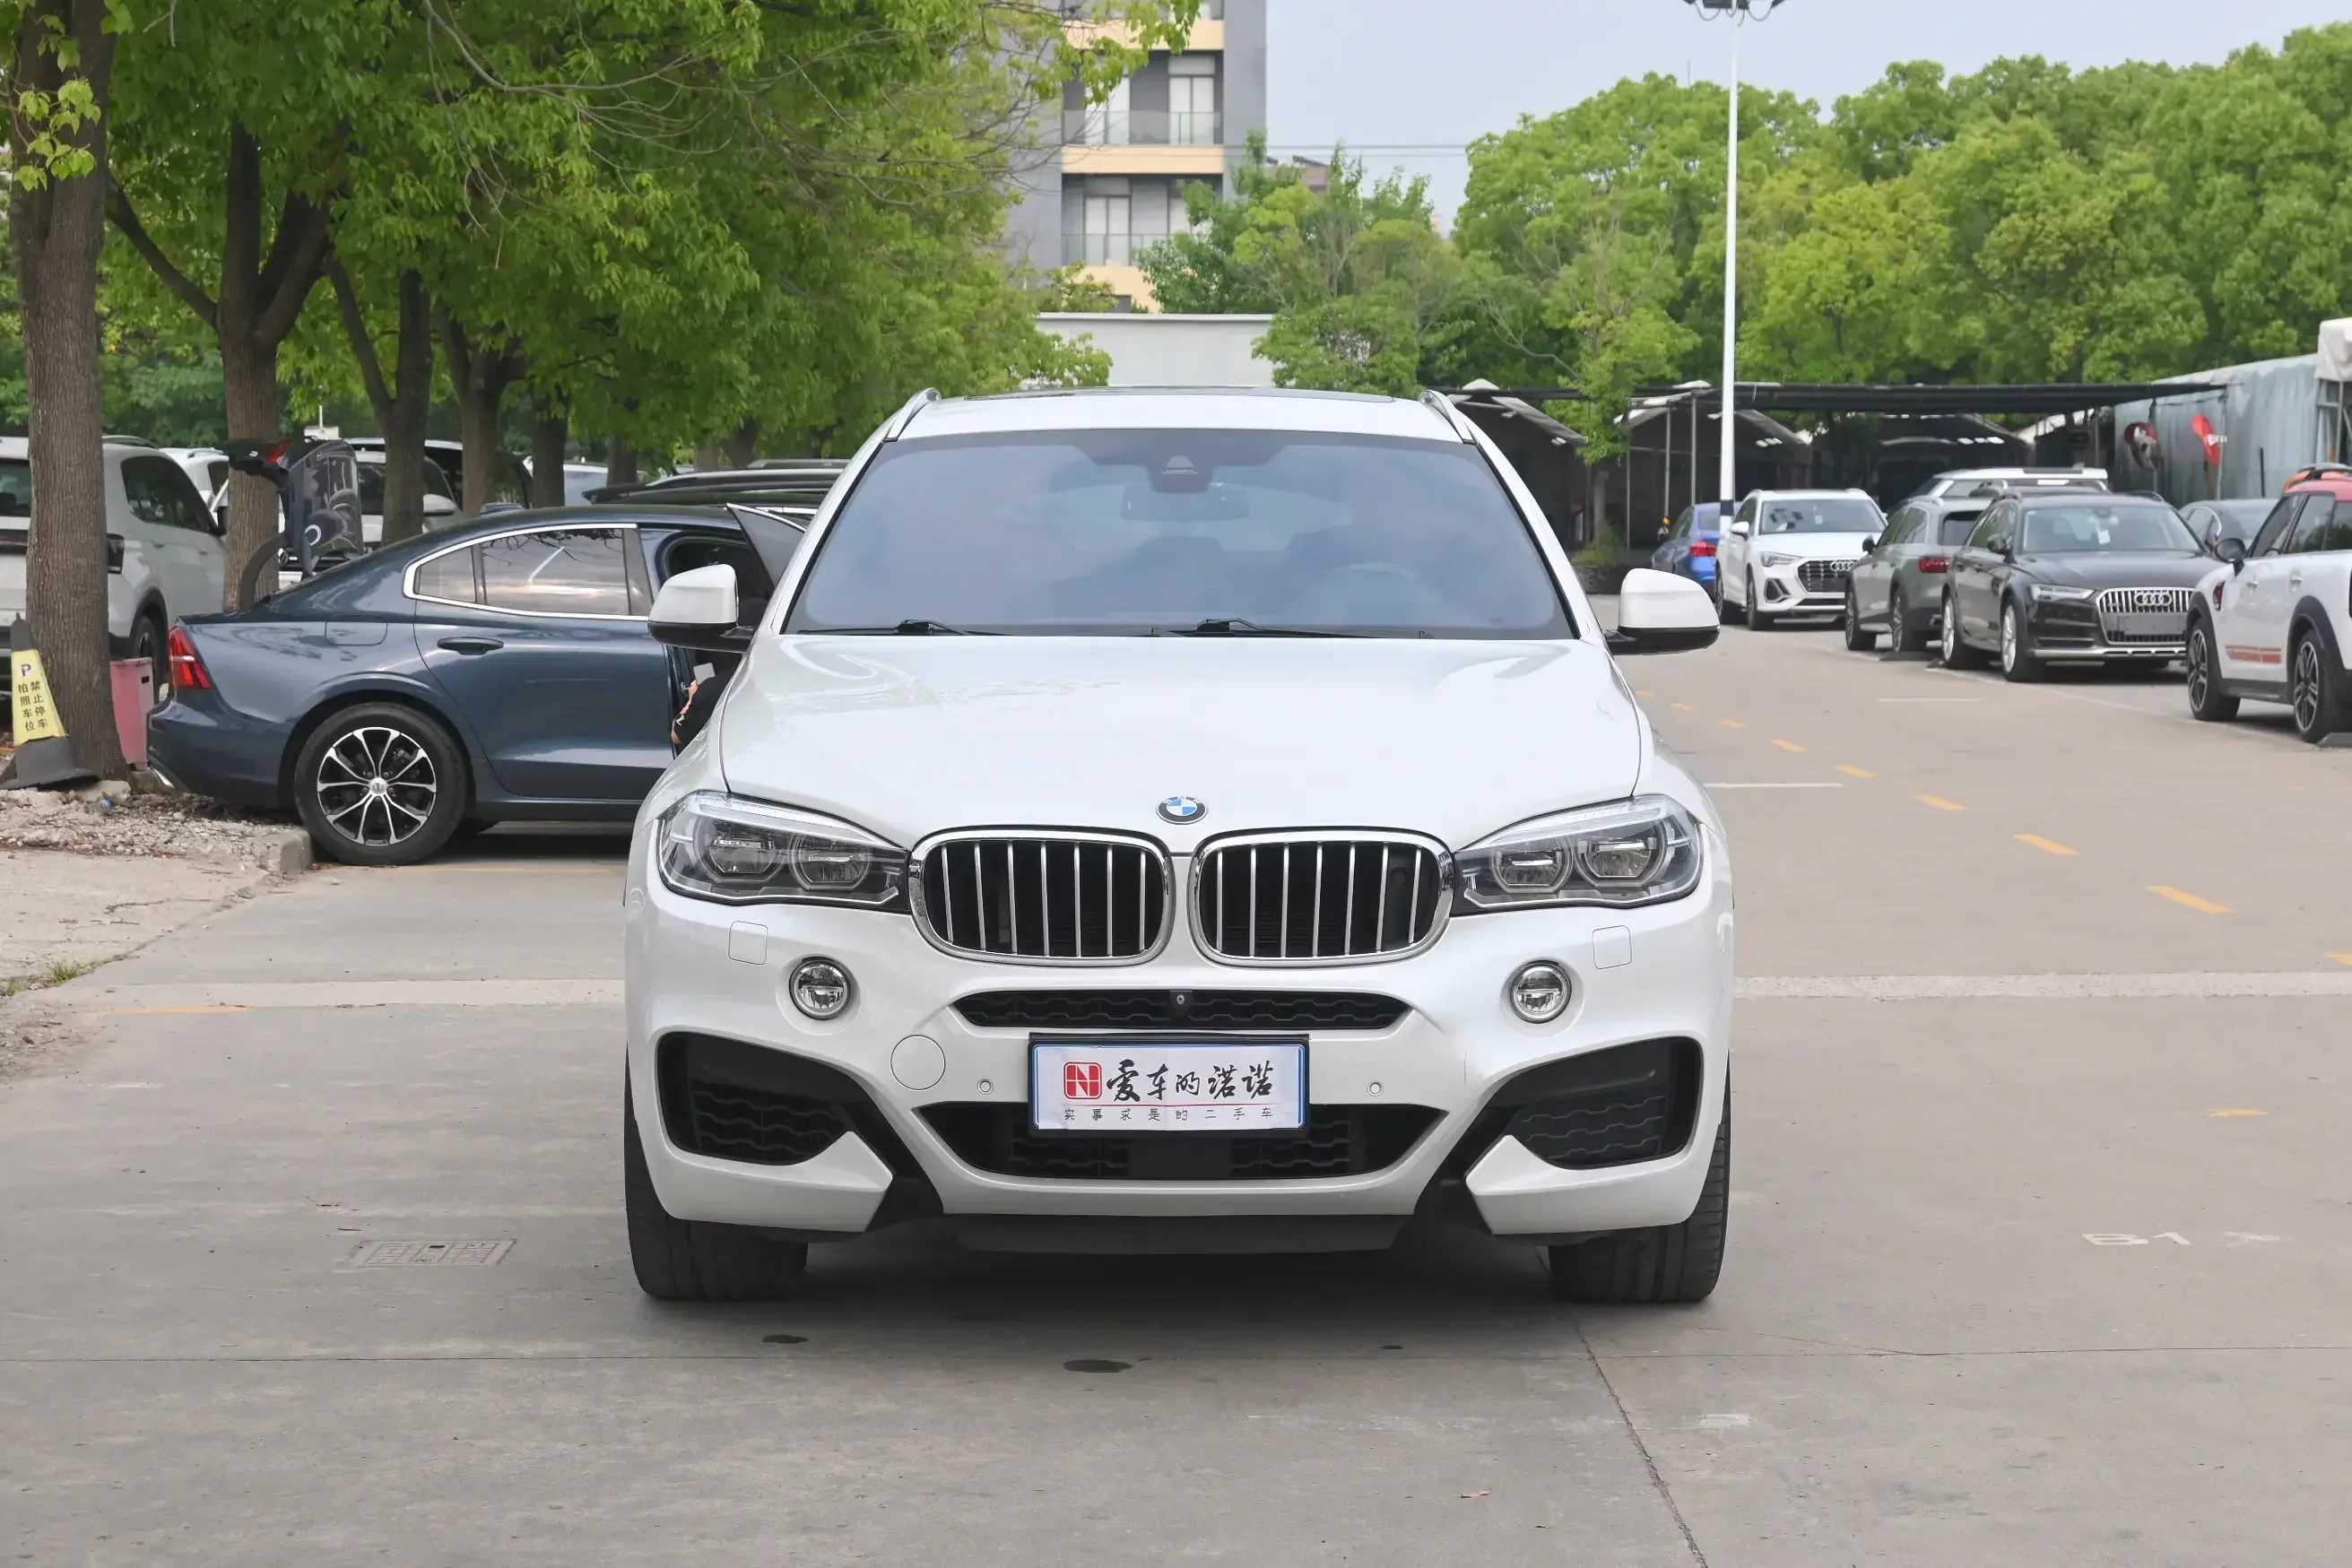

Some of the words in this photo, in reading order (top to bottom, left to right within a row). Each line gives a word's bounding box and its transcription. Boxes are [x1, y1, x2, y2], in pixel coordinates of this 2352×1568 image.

[30, 680, 48, 729] 禁止停车
[1063, 1107, 1273, 1122] 实事求是的二手车
